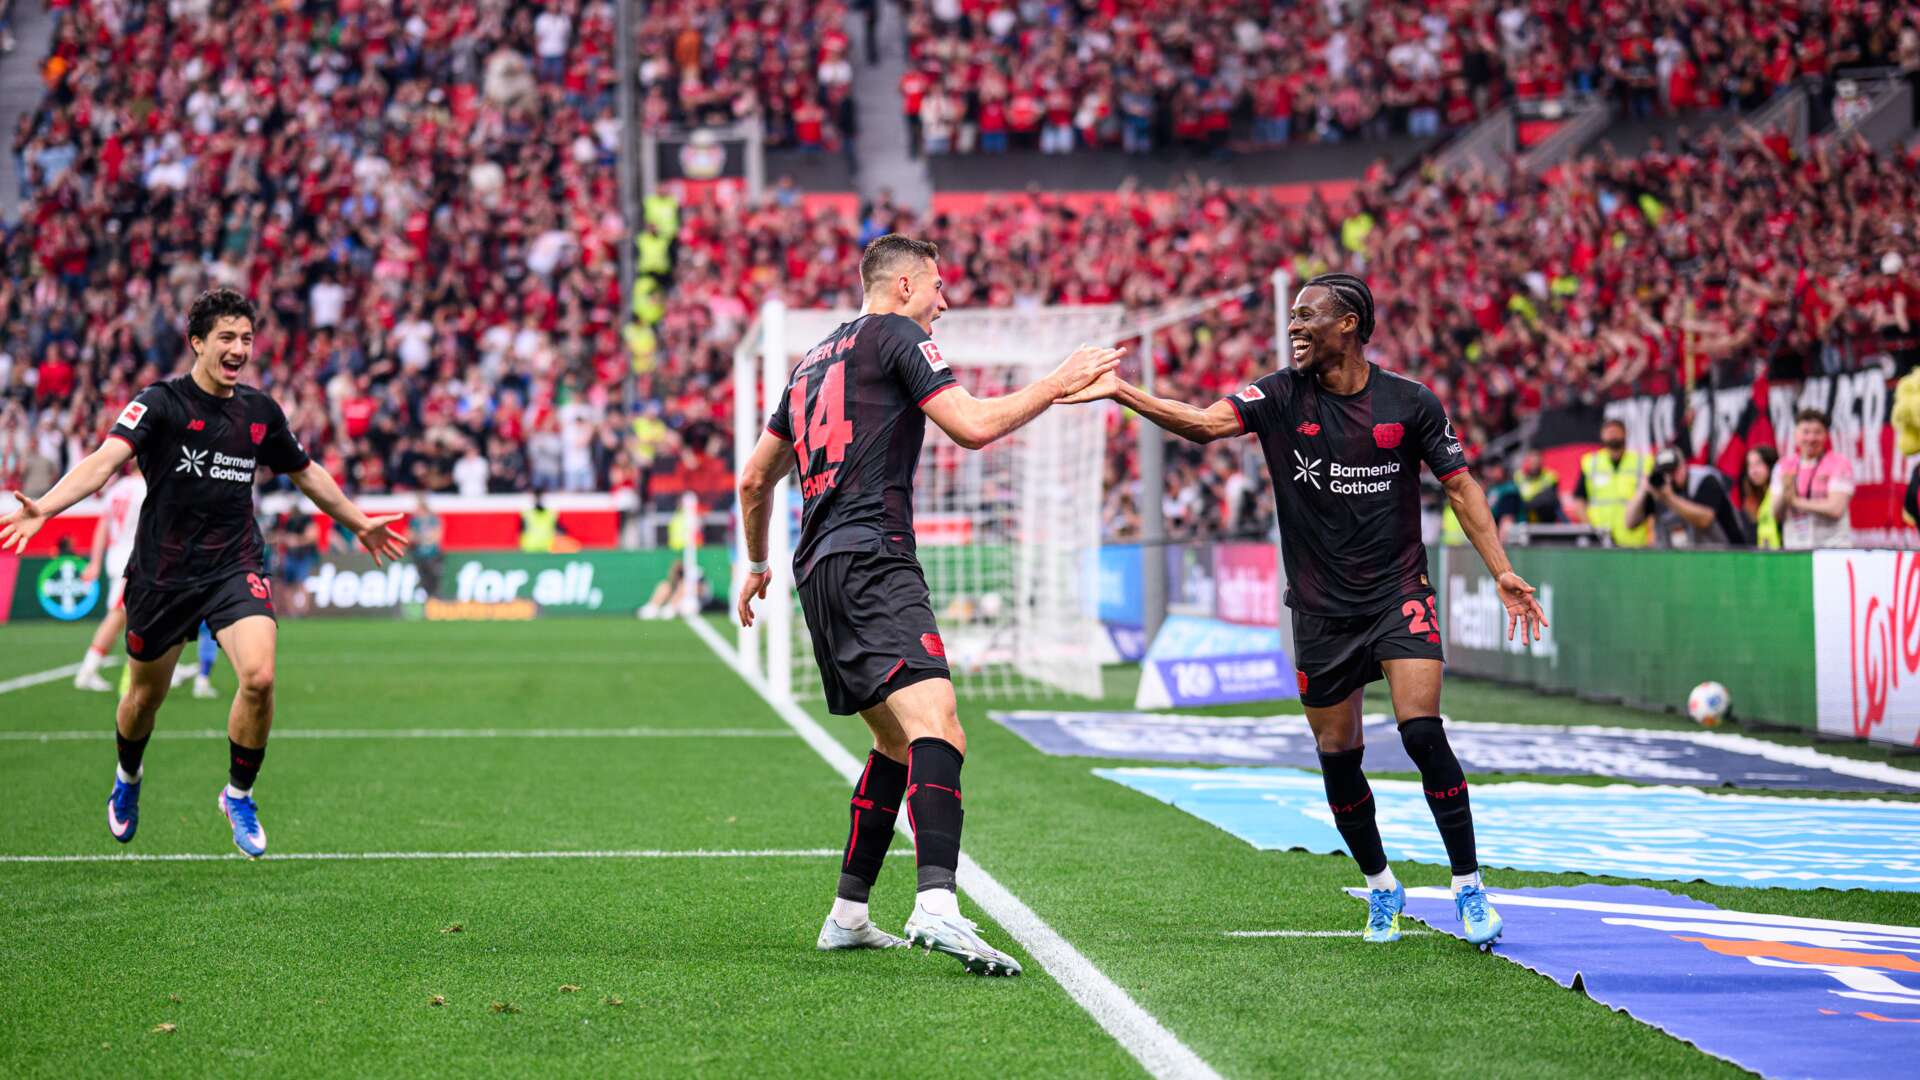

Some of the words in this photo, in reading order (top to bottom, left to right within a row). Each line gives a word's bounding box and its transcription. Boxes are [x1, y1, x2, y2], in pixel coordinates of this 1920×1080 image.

[788, 360, 853, 475] 14
[1330, 461, 1400, 478] Barmenia
[1330, 480, 1392, 494] Gothaer
[456, 561, 528, 603] for
